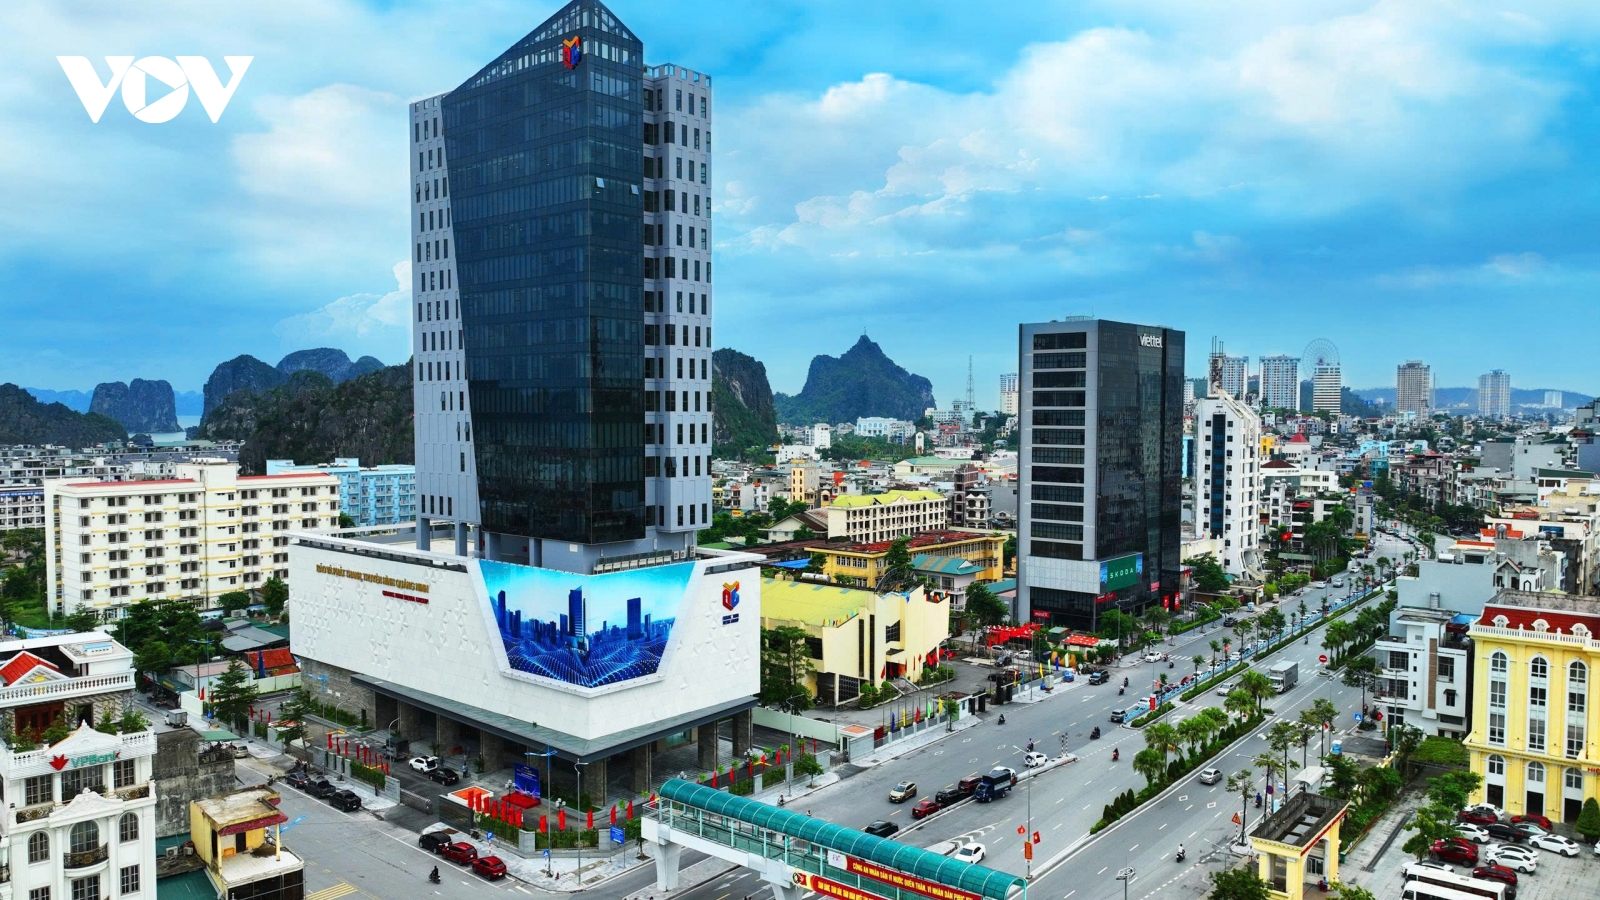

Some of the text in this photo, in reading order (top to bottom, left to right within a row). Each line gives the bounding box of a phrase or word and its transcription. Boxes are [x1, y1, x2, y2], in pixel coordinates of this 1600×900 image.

[1140, 334, 1162, 348] viettel
[1110, 568, 1134, 578] SKODA
[71, 750, 120, 768] VPBank
